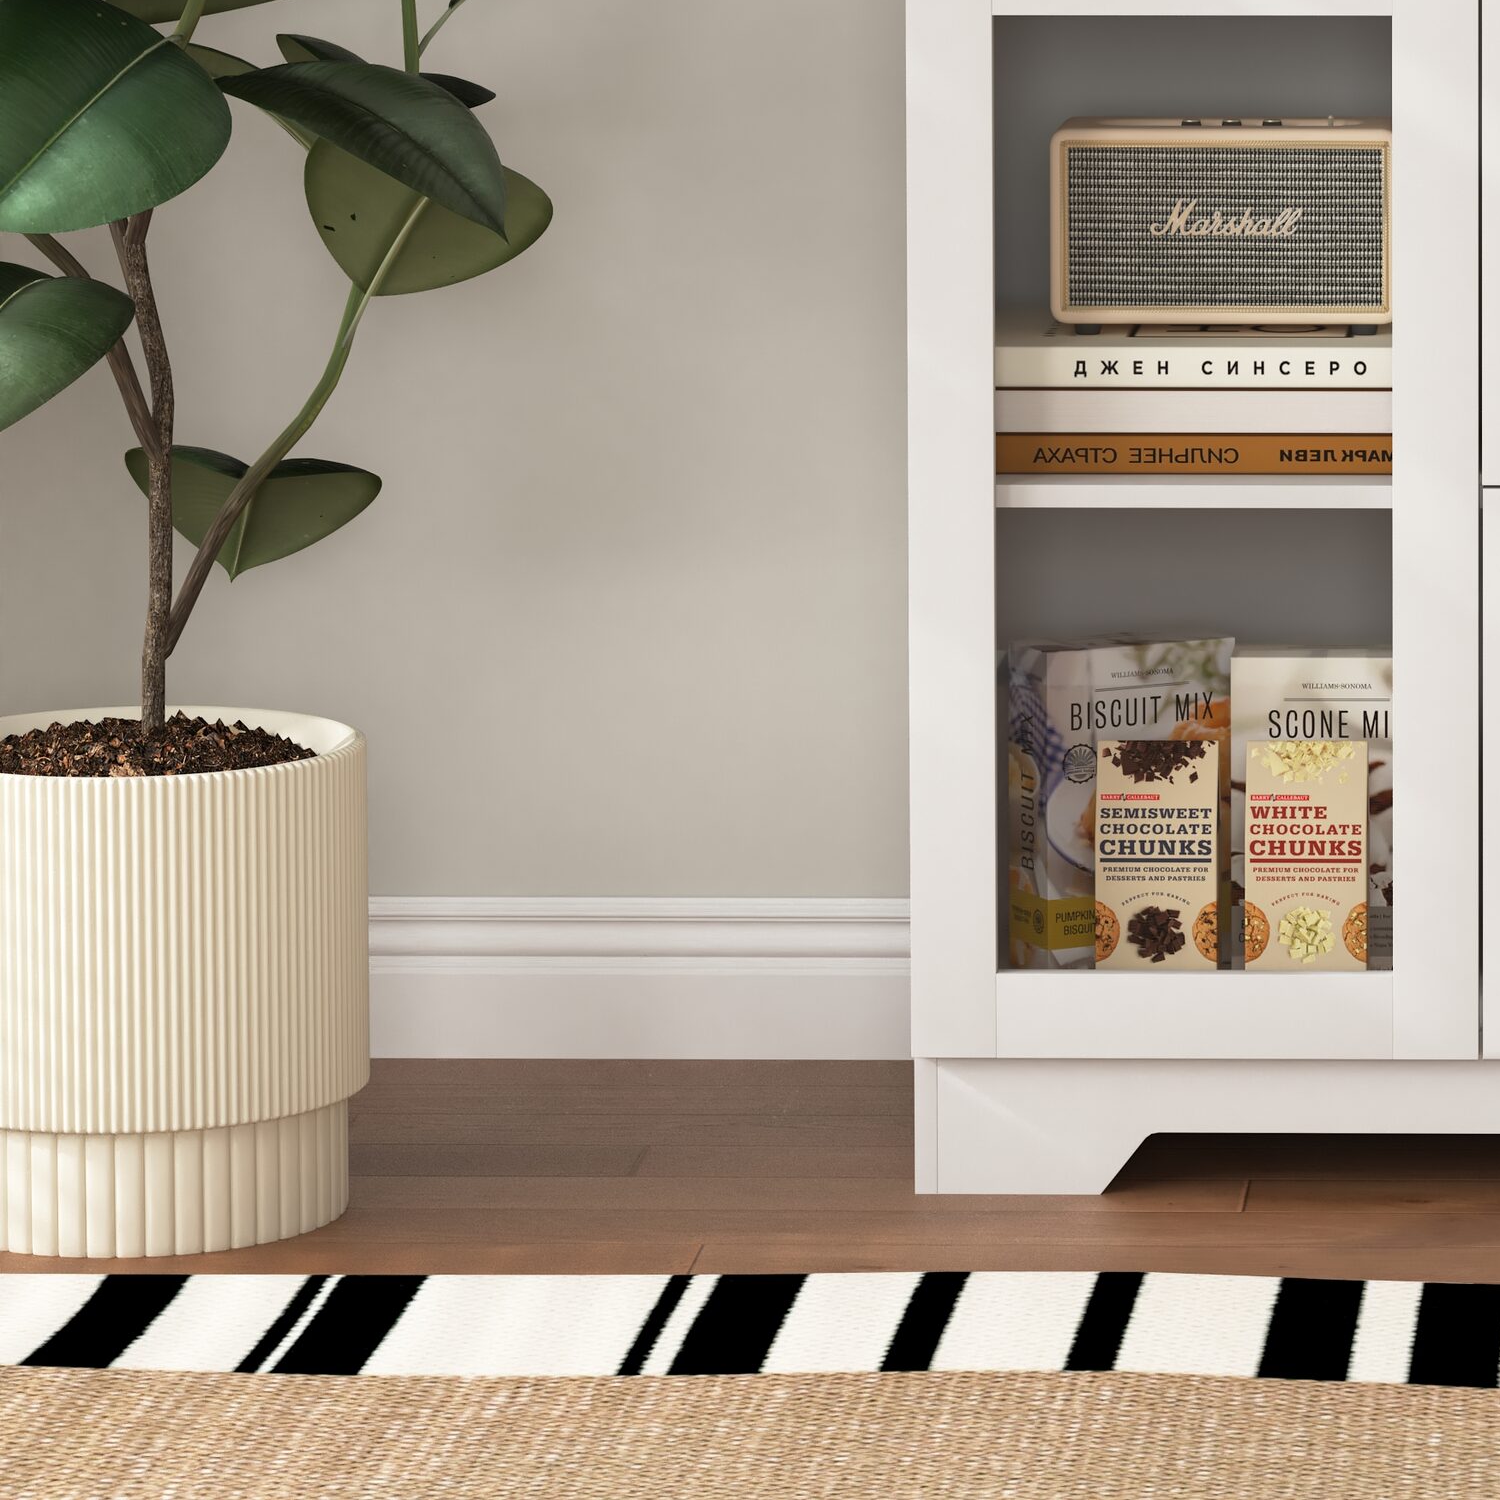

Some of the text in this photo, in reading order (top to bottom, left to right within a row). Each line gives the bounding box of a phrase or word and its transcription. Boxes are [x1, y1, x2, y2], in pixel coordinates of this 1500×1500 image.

[1150, 198, 1302, 238] Marshall
[1074, 360, 1367, 378] ДЖЕН СИНСЕРО
[1071, 692, 1213, 731] BISCUIT MIX
[1268, 710, 1388, 739] SCONE MI
[1100, 808, 1212, 819] SEMISWEET
[1250, 806, 1328, 819] WHITE
[1020, 772, 1036, 871] BISCUIT
[1100, 824, 1211, 835] CHOCOLATE
[1250, 824, 1361, 835] CHOCOLATE
[1100, 840, 1212, 855] CHUNKS
[1250, 841, 1362, 856] CHUNKS
[1122, 892, 1149, 906] PERFECT
[1167, 892, 1190, 905] BAKING
[1272, 893, 1299, 907] PERFECT
[1317, 893, 1340, 906] BAKING
[1055, 909, 1095, 923] PUMPKIN
